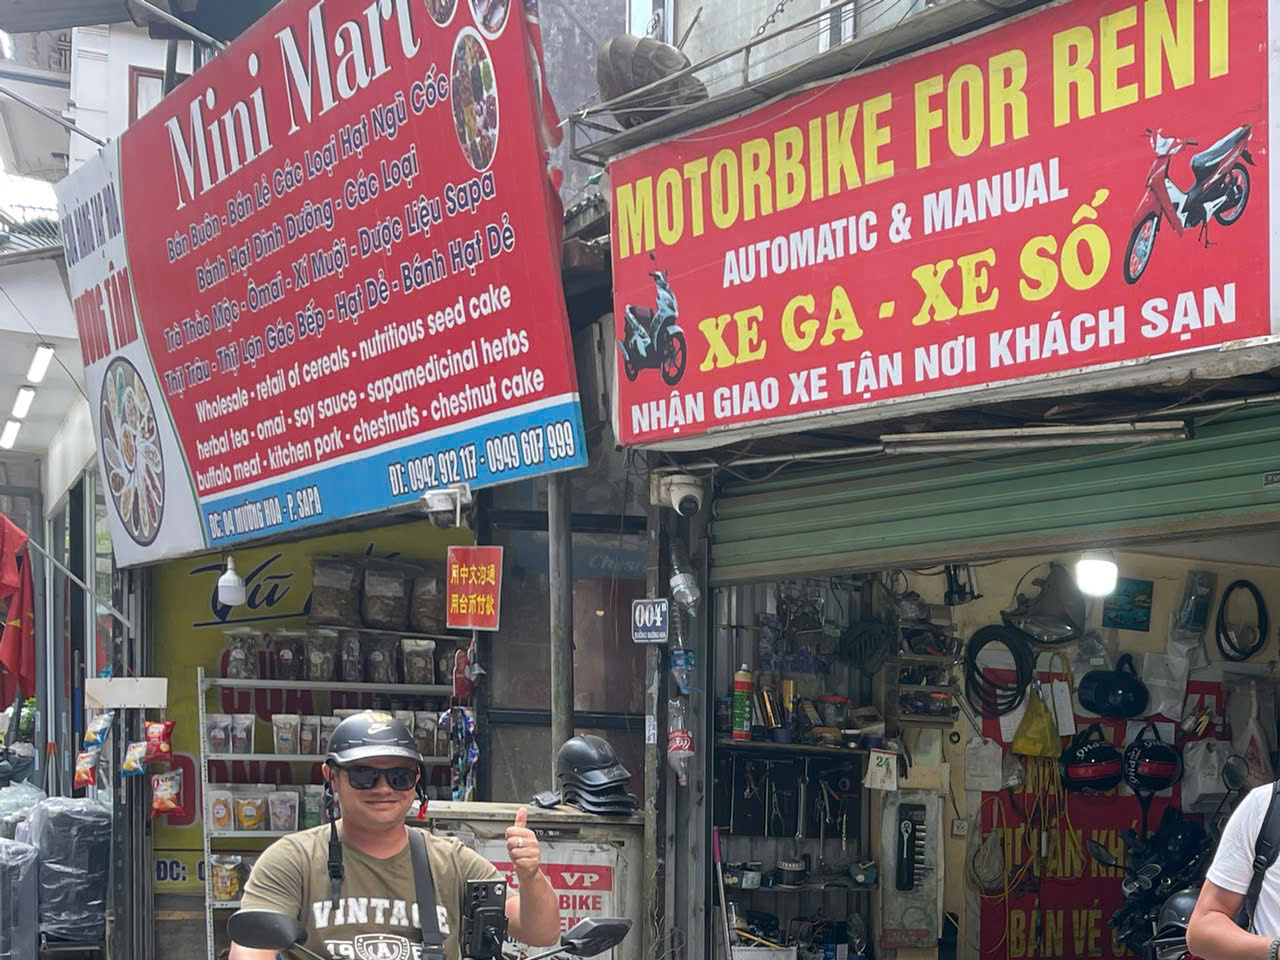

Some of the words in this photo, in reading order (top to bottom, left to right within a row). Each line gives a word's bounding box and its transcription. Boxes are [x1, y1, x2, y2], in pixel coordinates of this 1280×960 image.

[164, 53, 273, 210] Mini
[275, 0, 421, 135] Mart
[166, 230, 189, 263] Bán
[227, 190, 253, 227] Bán
[272, 160, 303, 197] Các
[305, 135, 338, 180] Loại
[339, 115, 369, 158] Hạt
[371, 90, 408, 140] Ngũ
[410, 63, 449, 115] Cốc
[616, 92, 895, 259] MOTORBIKE
[914, 48, 1029, 169] FOR
[1052, 0, 1229, 128] RENT
[182, 310, 211, 344] Thảo
[211, 297, 240, 332] Mộc
[292, 254, 310, 291] Xí
[310, 238, 349, 279] Muội
[358, 216, 402, 258] Dược
[404, 194, 442, 237] Liệu
[444, 171, 496, 217] Sapa
[196, 255, 228, 293] Bánh
[227, 239, 252, 276] Hạt
[252, 222, 285, 261] Dinh
[285, 199, 334, 243] Dưỡng
[344, 169, 379, 210] Các
[380, 144, 419, 191] Loại
[265, 316, 295, 352] Gác
[296, 298, 325, 339] Bếp
[335, 283, 364, 325] Hạt
[365, 269, 390, 309] Dẻ
[400, 252, 447, 294] Bánh
[448, 230, 483, 276] Hạt
[486, 212, 515, 258] Dẻ
[698, 308, 766, 371] XE
[781, 284, 863, 352] GA
[912, 249, 1000, 328] XE
[1020, 188, 1111, 301] SỐ
[722, 202, 877, 288] AUTOMATIC
[888, 201, 912, 241] &
[923, 157, 1068, 235] MANUAL
[195, 386, 249, 423] Wholesale
[256, 368, 286, 400] retail
[288, 362, 301, 388] of
[302, 345, 350, 382] cereals
[359, 318, 425, 360] nutritious
[427, 296, 466, 335] seed
[469, 284, 511, 319] cake
[197, 430, 229, 460] herbal
[231, 428, 249, 449] tea
[256, 410, 286, 440] omai
[294, 404, 315, 428] soy
[318, 389, 357, 420] sauce
[367, 340, 478, 403] sapamedicinal
[481, 328, 529, 365] herbs
[630, 379, 704, 434] NHẬN
[714, 375, 780, 417] GIAO
[789, 371, 828, 406] XE
[840, 350, 902, 406] TẬN
[914, 334, 977, 380] NƠI
[989, 303, 1126, 369] KHÁCH
[1141, 283, 1236, 341] SẠN
[196, 463, 232, 491] buffalo
[233, 453, 261, 481] meat
[268, 440, 312, 470] kitchen
[314, 426, 344, 461] pork
[353, 402, 419, 444] chestnuts
[430, 375, 498, 421] chestnut
[501, 366, 544, 400] cake
[408, 456, 439, 492] 0942
[440, 451, 459, 485] 912
[486, 434, 520, 473] 0949
[521, 428, 544, 466] 607
[547, 420, 575, 458] 999
[298, 486, 322, 519] SAPA
[876, 756, 890, 768] 24
[561, 872, 599, 887] VP
